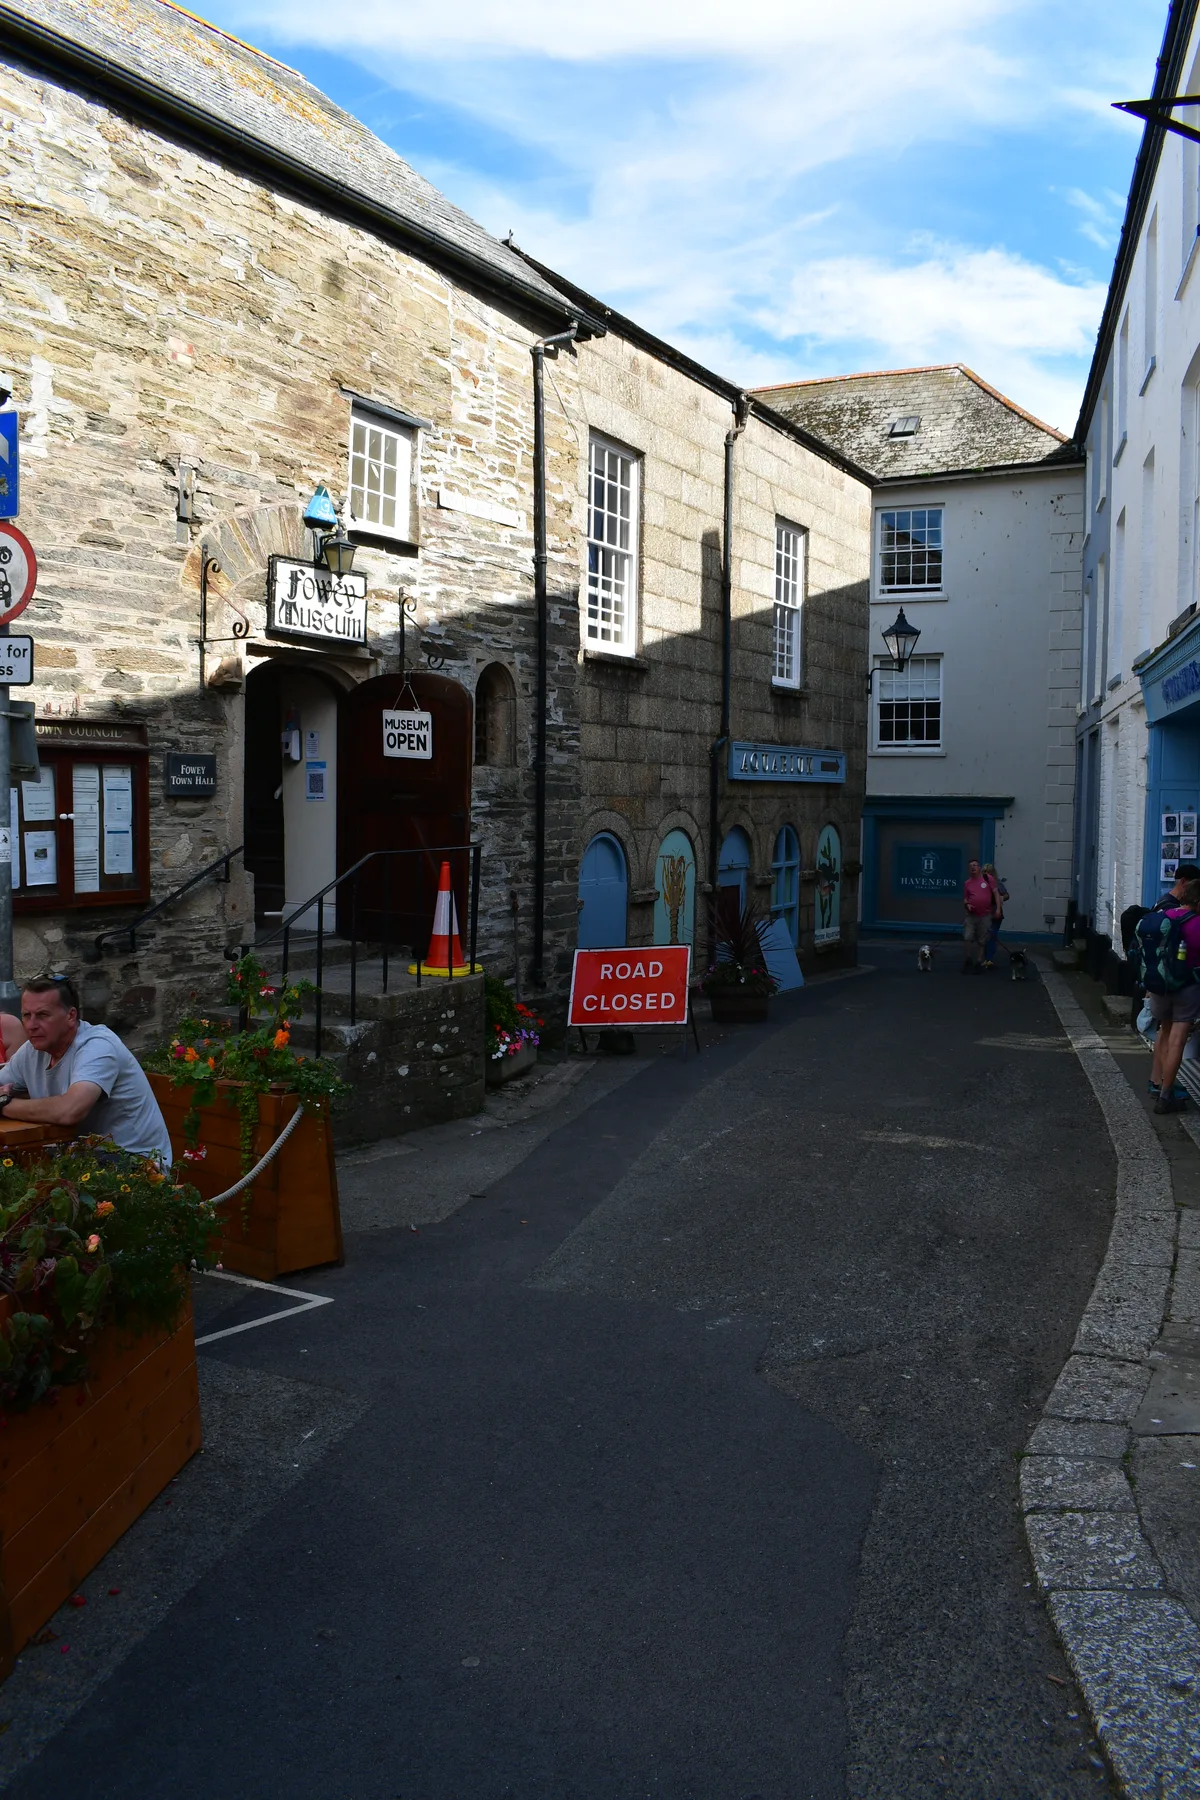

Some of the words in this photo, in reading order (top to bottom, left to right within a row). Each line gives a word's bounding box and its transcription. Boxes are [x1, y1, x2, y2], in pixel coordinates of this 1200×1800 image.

[287, 569, 356, 614] Fowey
[279, 598, 362, 638] Museum
[7, 644, 28, 658] for
[36, 725, 62, 736] OWN
[69, 726, 122, 738] COUNCIL
[385, 719, 429, 731] MUSEUM
[387, 732, 427, 751] OPEN
[740, 752, 813, 775] AQUARIUM
[171, 775, 193, 785] TOWN
[195, 775, 215, 785] HALL
[901, 877, 957, 887] HAVENER'S
[600, 961, 663, 980] ROAD
[582, 992, 676, 1012] CLOSED
